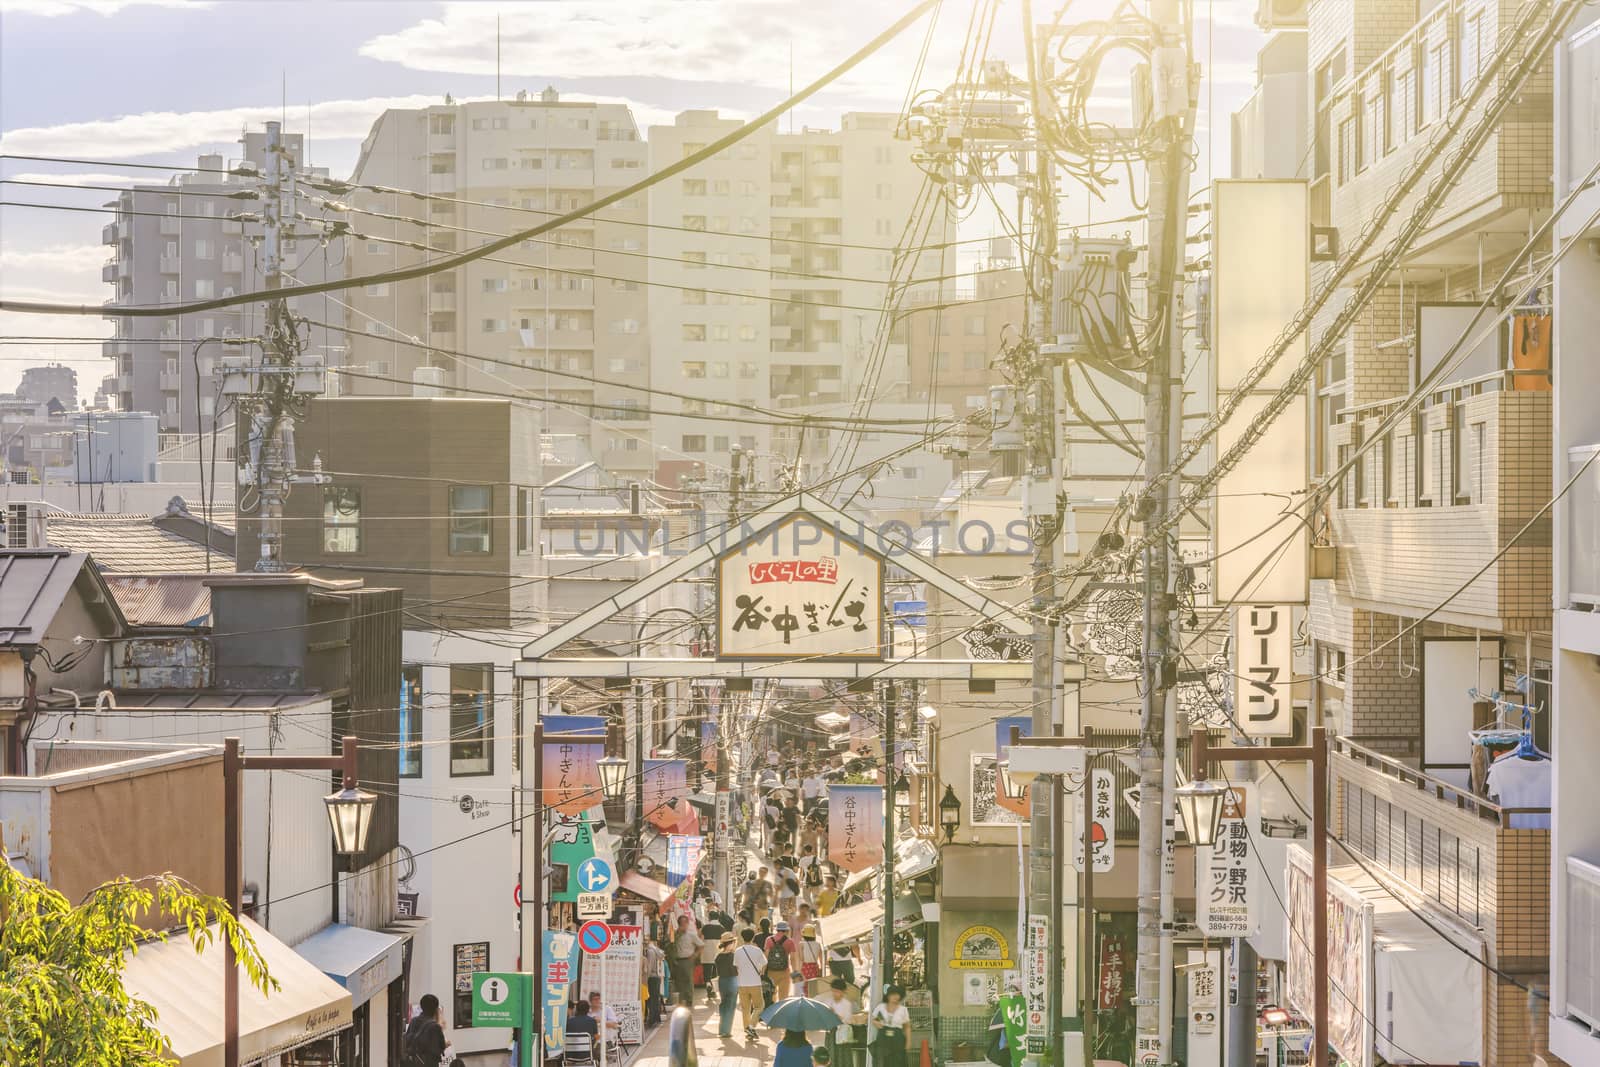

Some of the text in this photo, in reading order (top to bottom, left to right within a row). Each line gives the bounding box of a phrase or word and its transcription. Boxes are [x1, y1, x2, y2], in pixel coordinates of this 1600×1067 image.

[750, 556, 839, 584] ひぐらしの里
[1248, 605, 1280, 721] リーマン
[1096, 777, 1110, 818] かき氷
[844, 795, 857, 863] 谷中ぎんざ
[579, 903, 608, 911] 一方通行
[1208, 922, 1248, 931] 3894-7739
